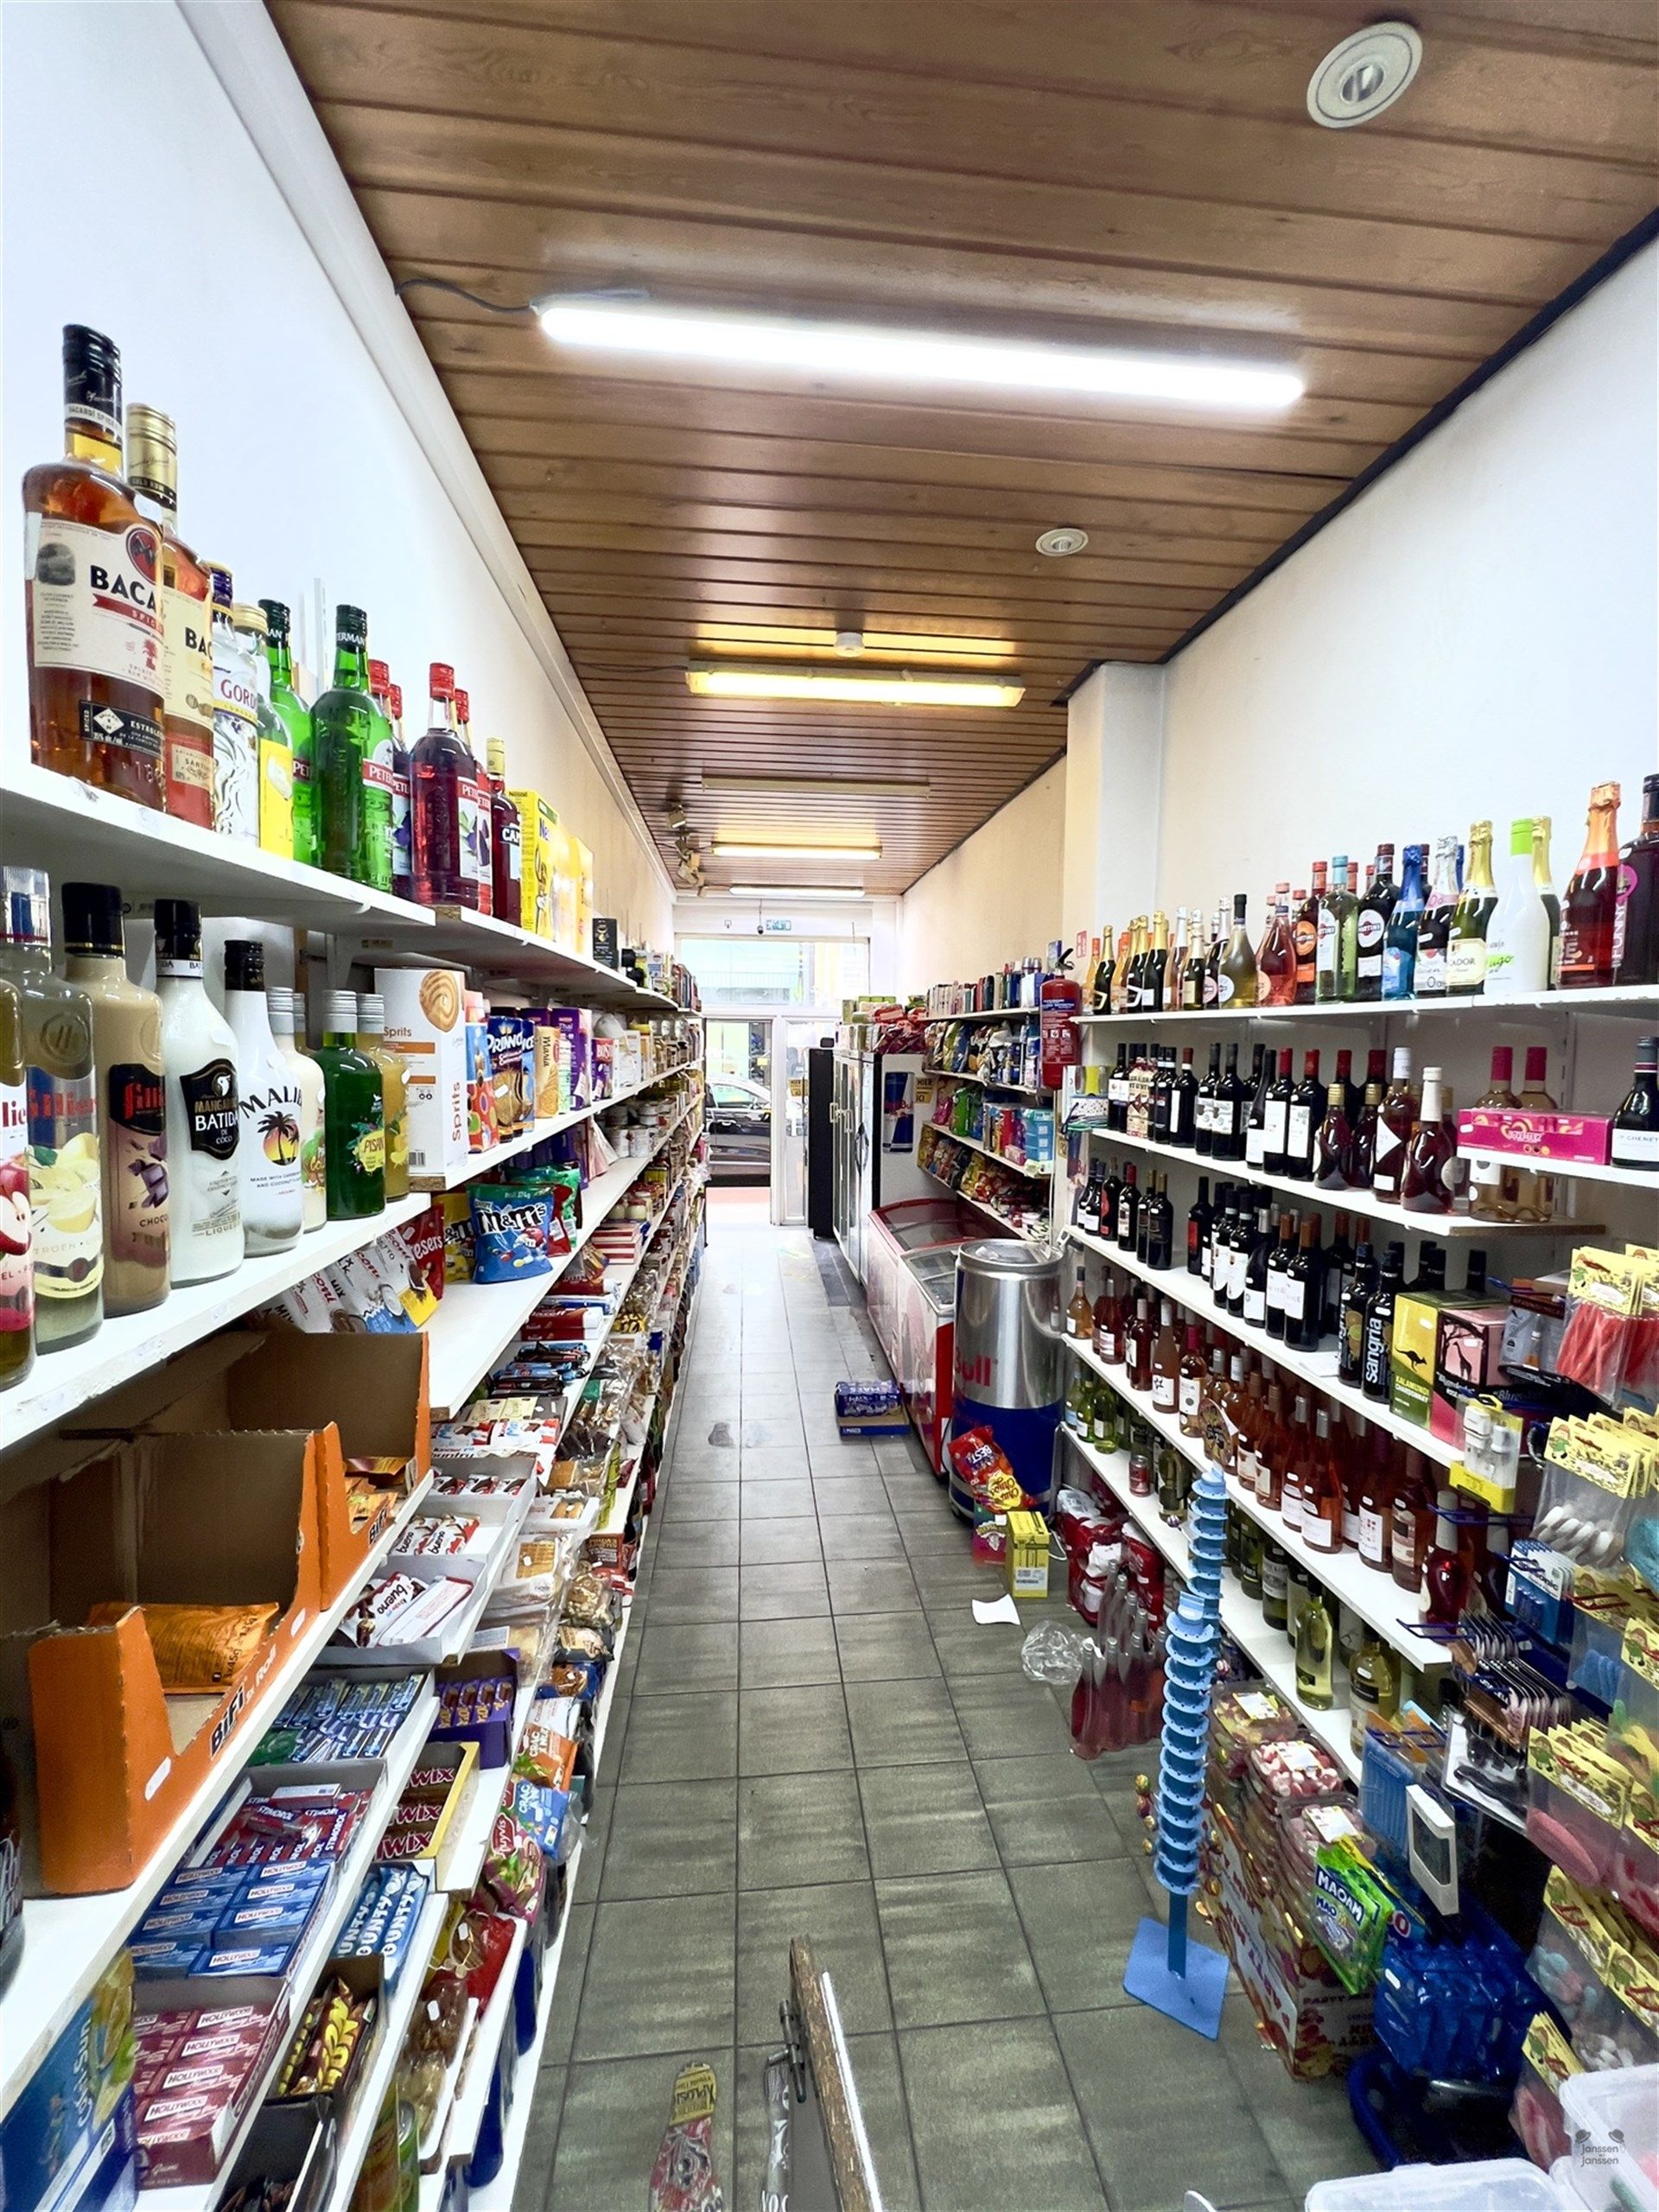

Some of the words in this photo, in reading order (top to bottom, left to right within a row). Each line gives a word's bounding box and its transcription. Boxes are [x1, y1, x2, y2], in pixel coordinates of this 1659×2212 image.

[383, 1026, 413, 1039] Sprits
[542, 1034, 551, 1068] Maria
[452, 1081, 461, 1141] Sprits
[1365, 1316, 1384, 1384] sangria
[376, 1583, 409, 1615] bueno
[1317, 1869, 1364, 1923] MAOAM
